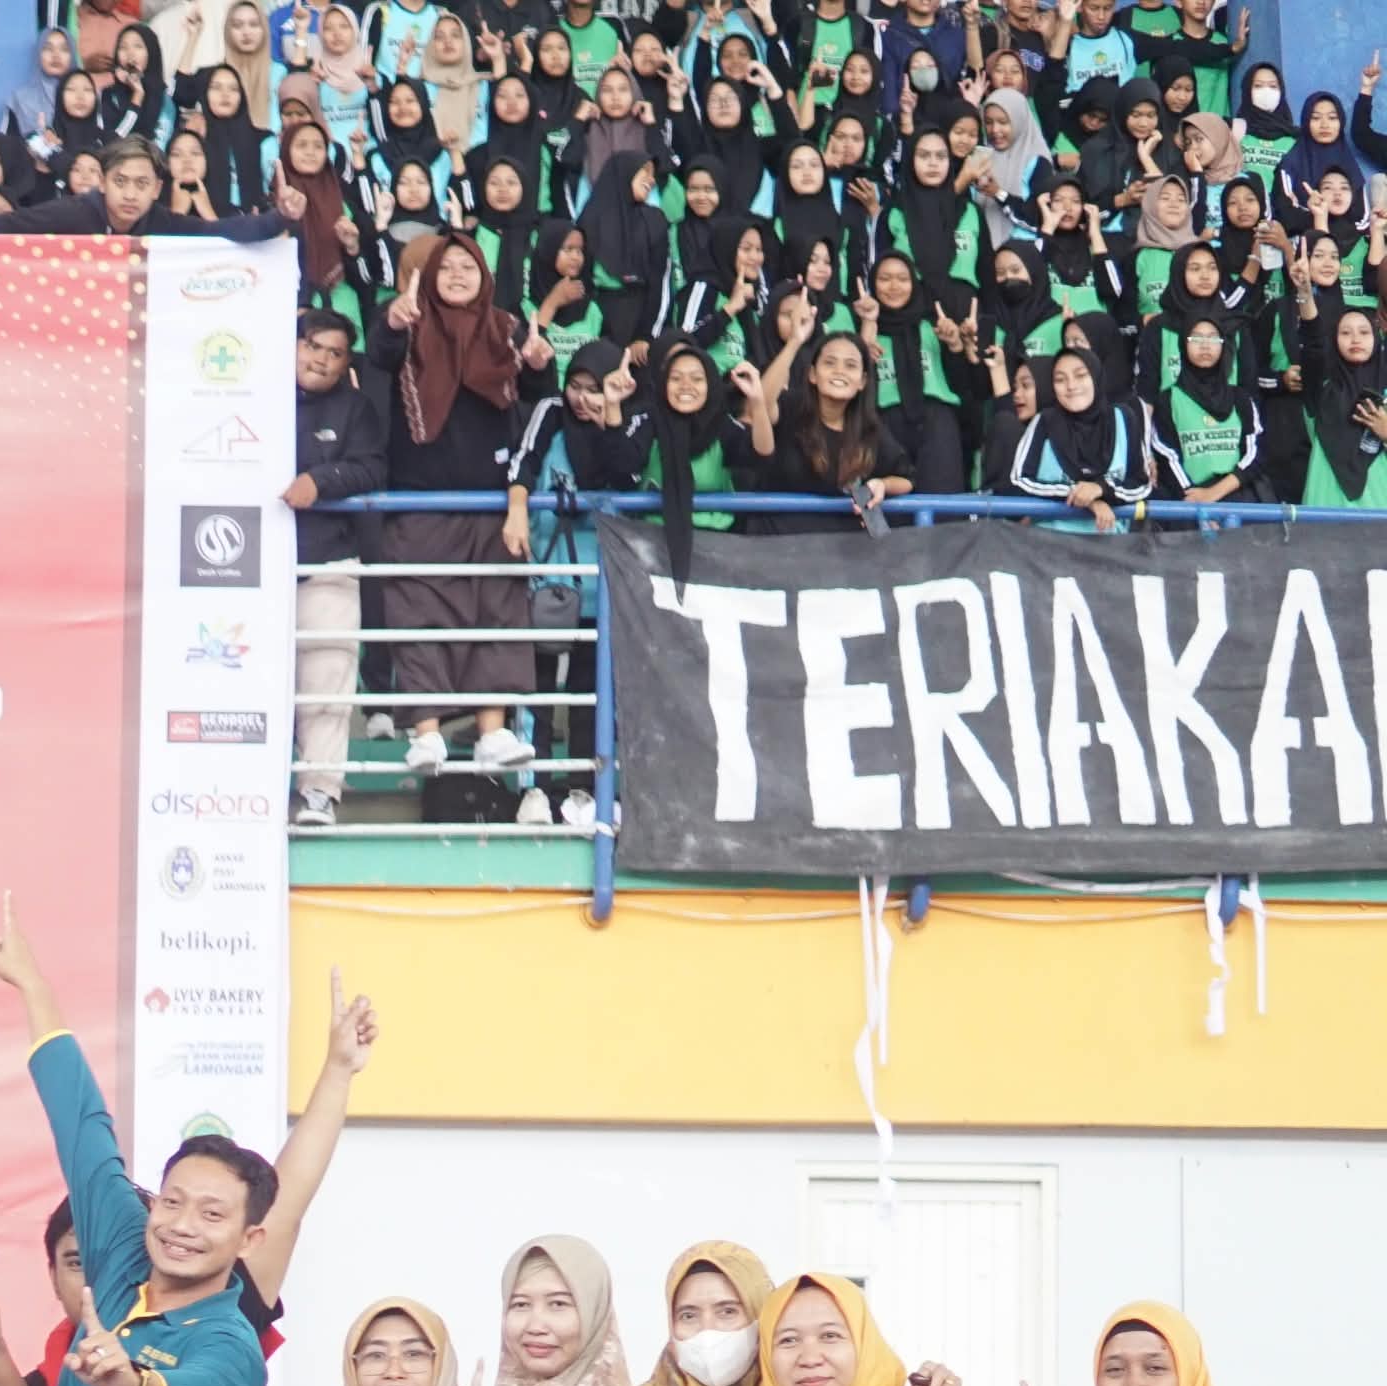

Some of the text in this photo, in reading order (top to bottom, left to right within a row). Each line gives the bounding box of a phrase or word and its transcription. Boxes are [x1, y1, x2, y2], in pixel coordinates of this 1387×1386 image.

[648, 568, 1387, 832] TERIAKA
[150, 784, 270, 819] dispora
[160, 930, 257, 956] belikopi.
[173, 988, 264, 1003] LYLY BAKERY
[182, 1062, 265, 1075] LAMONGAN
